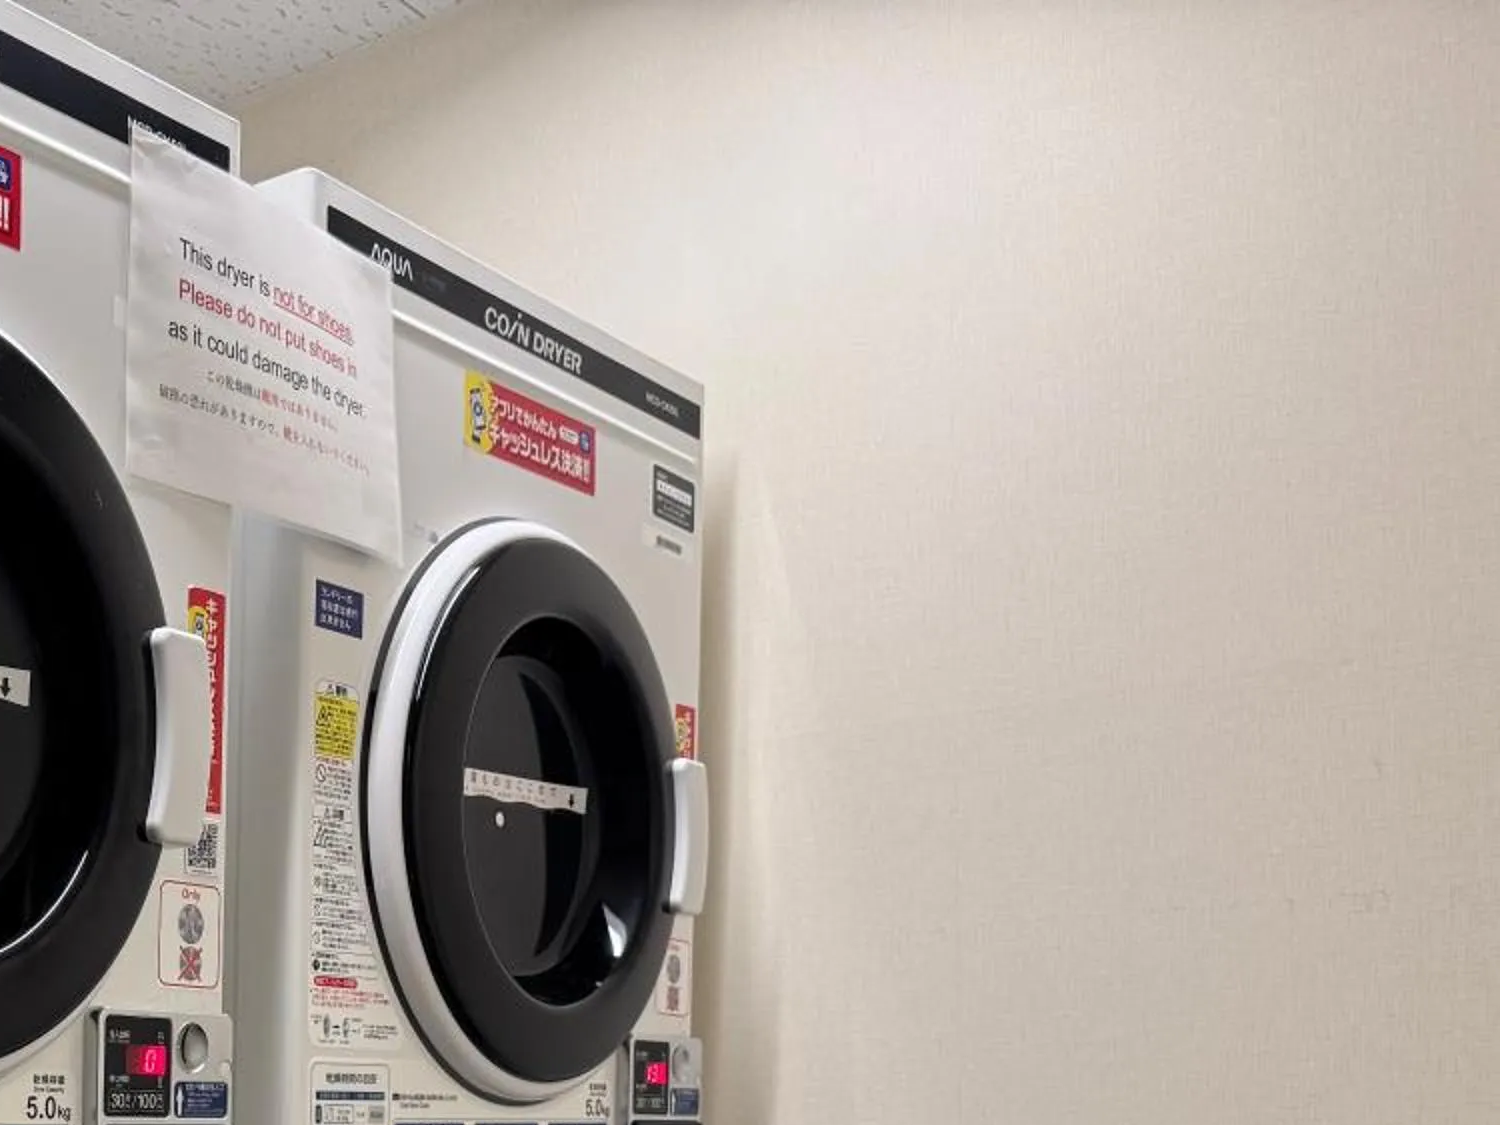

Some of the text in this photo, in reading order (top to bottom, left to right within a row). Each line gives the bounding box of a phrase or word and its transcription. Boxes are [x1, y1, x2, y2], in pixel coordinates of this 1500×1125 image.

[180, 237, 213, 271] This
[217, 257, 254, 288] dryer
[260, 273, 270, 297] is
[273, 287, 295, 310] not
[297, 294, 314, 317] for
[371, 242, 413, 281] AQUA
[533, 332, 582, 375] DRYER
[168, 320, 188, 341] as
[193, 323, 202, 349] it
[207, 335, 248, 365] could
[252, 350, 308, 391] damage
[311, 374, 331, 401] the
[180, 278, 357, 379] Please do not put shoes in
